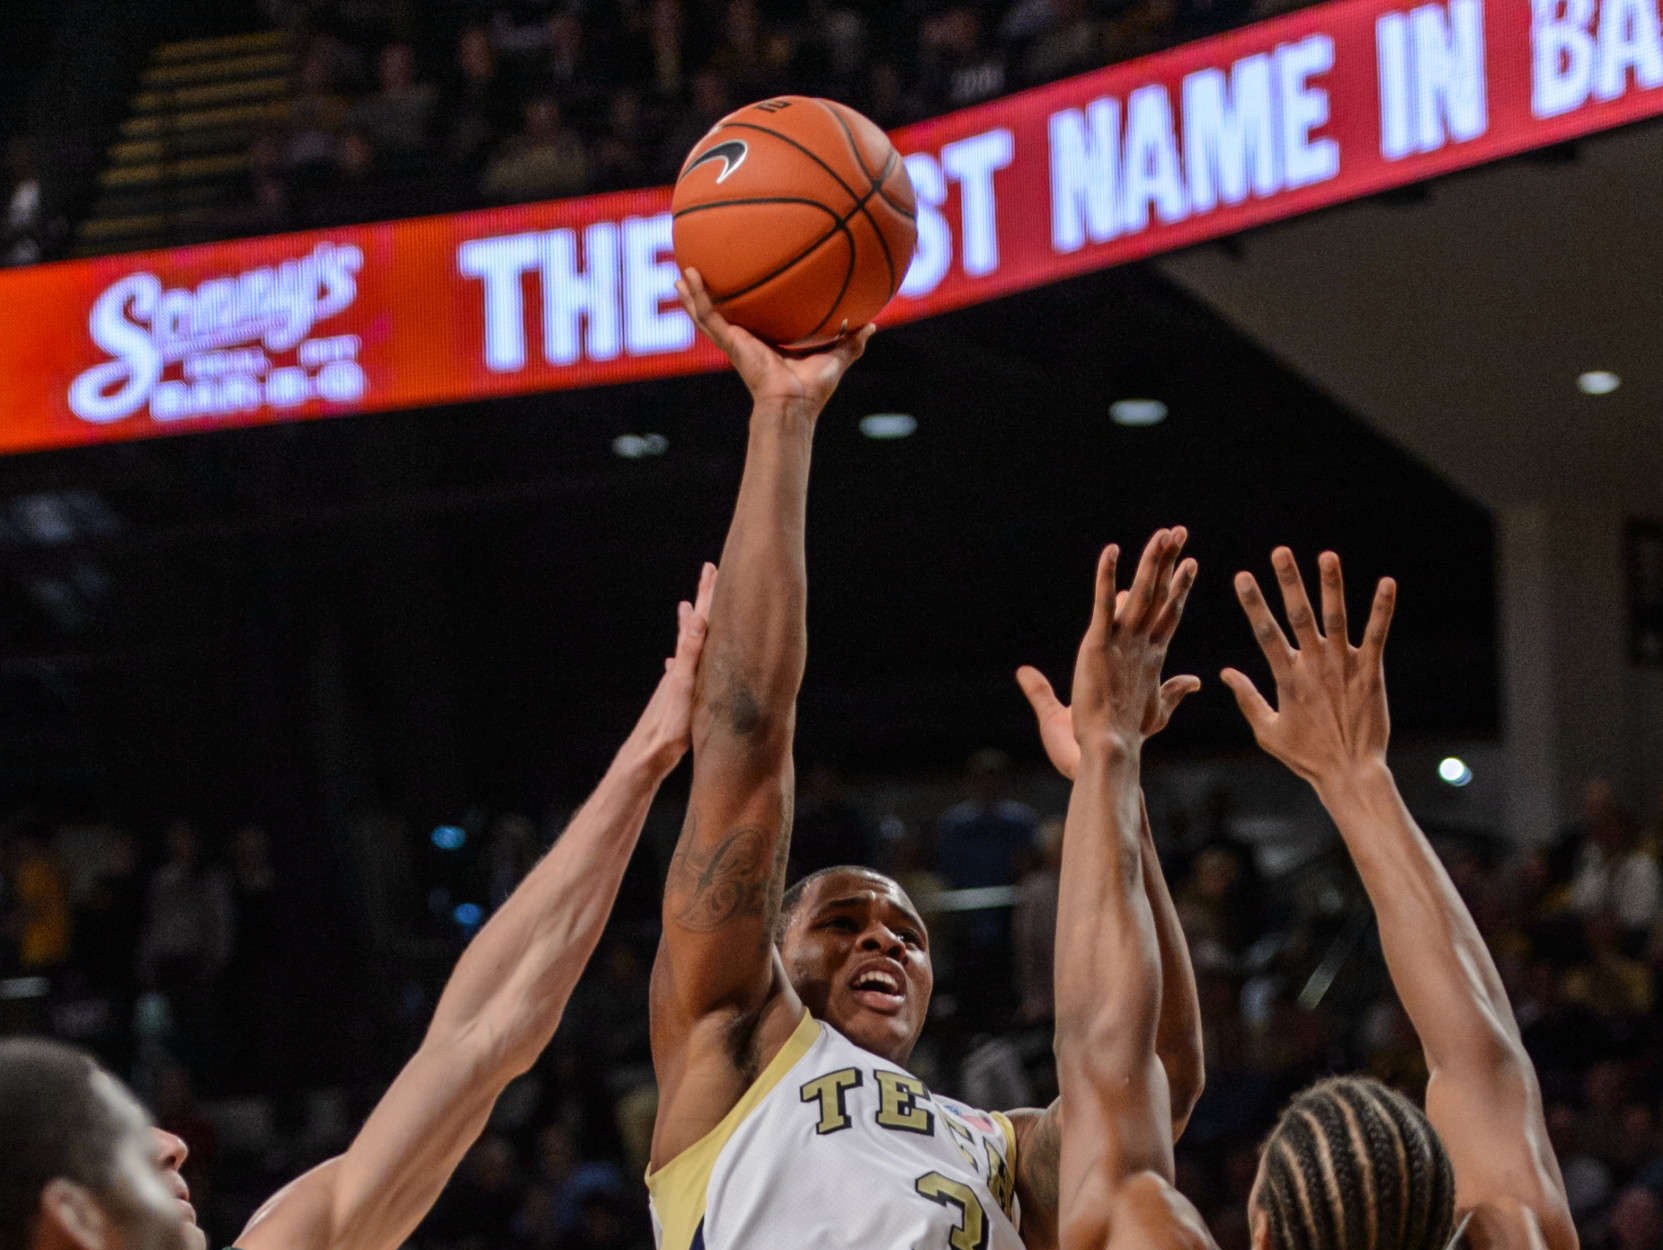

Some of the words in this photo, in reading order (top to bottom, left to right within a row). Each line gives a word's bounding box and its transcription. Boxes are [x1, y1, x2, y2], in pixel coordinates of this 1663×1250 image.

[457, 213, 697, 373] THE
[1048, 34, 1340, 254] NAME
[1375, 2, 1488, 161] IN
